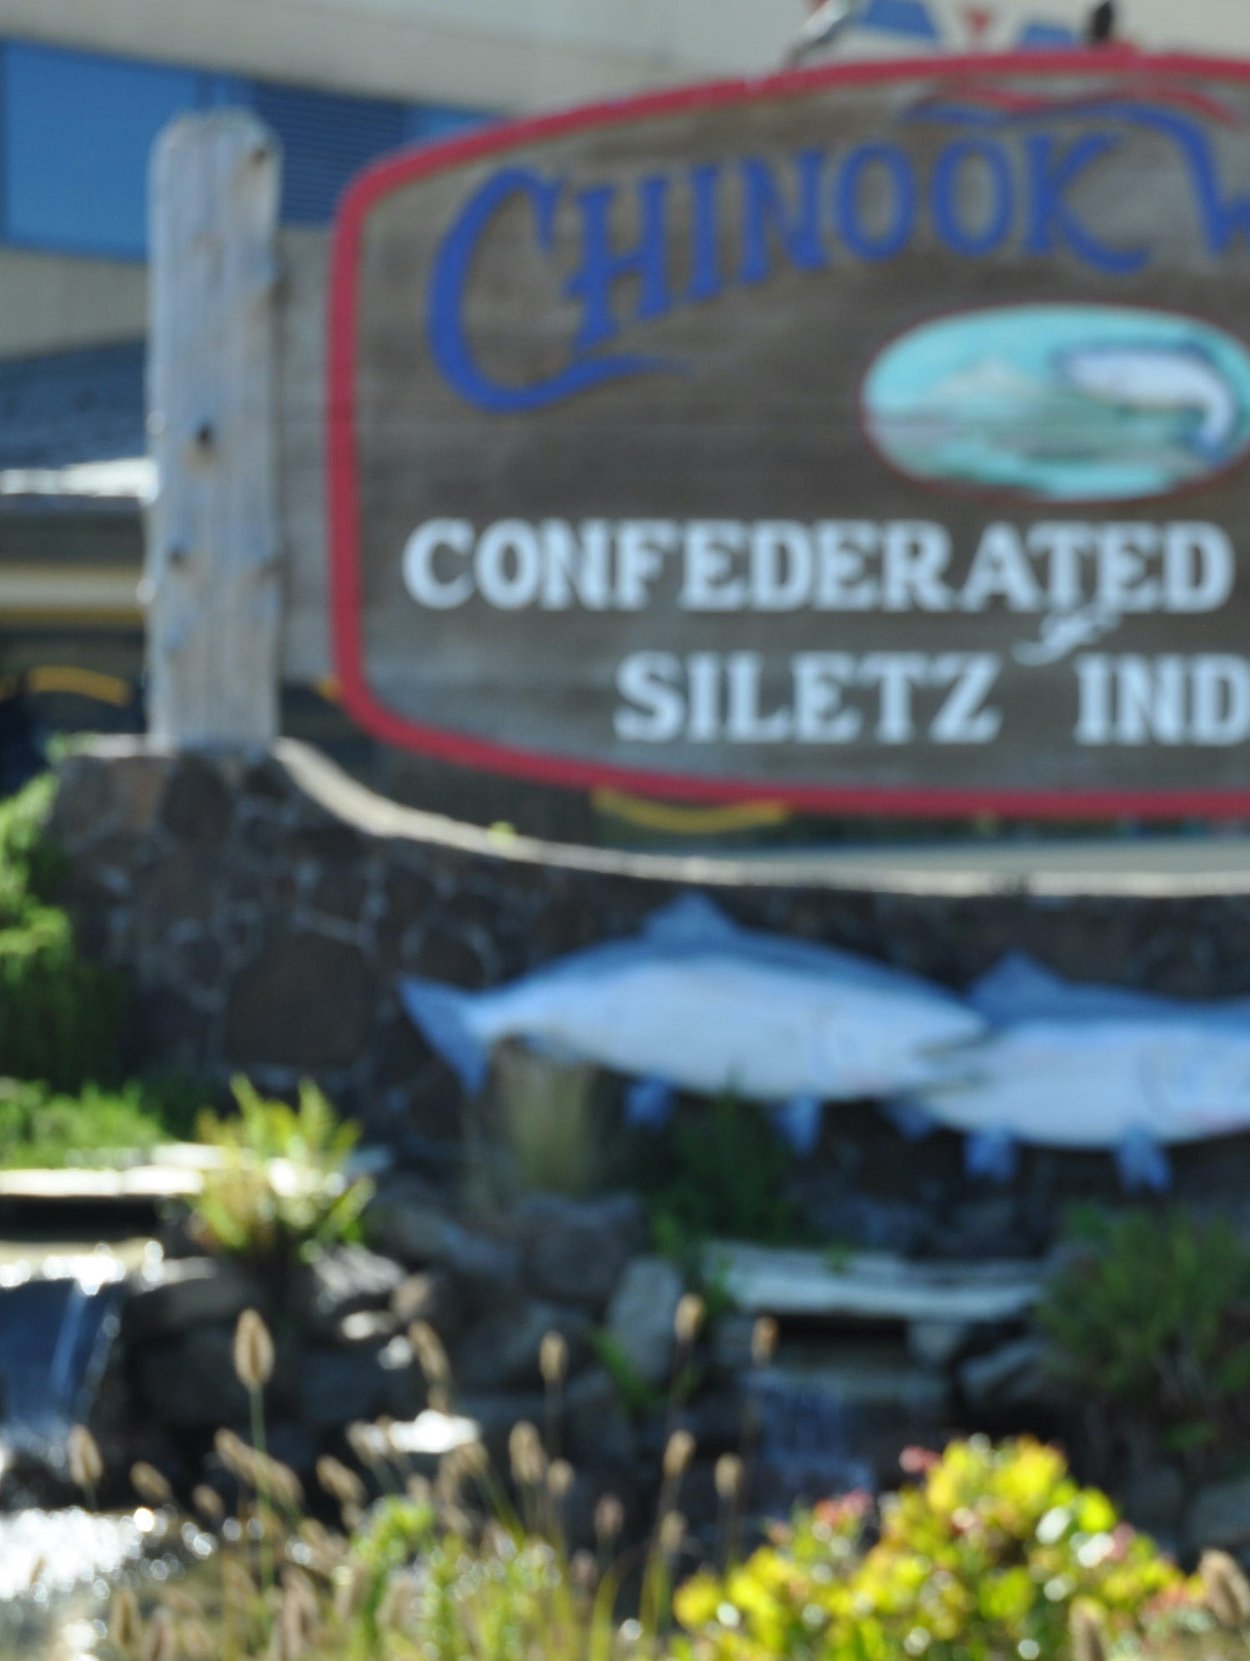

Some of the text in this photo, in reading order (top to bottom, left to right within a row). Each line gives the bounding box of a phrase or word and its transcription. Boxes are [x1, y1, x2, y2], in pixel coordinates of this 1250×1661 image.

[427, 132, 1150, 412] CHINOOK
[402, 519, 1236, 614] CONFEDERATED
[612, 652, 1001, 746] SILETZ
